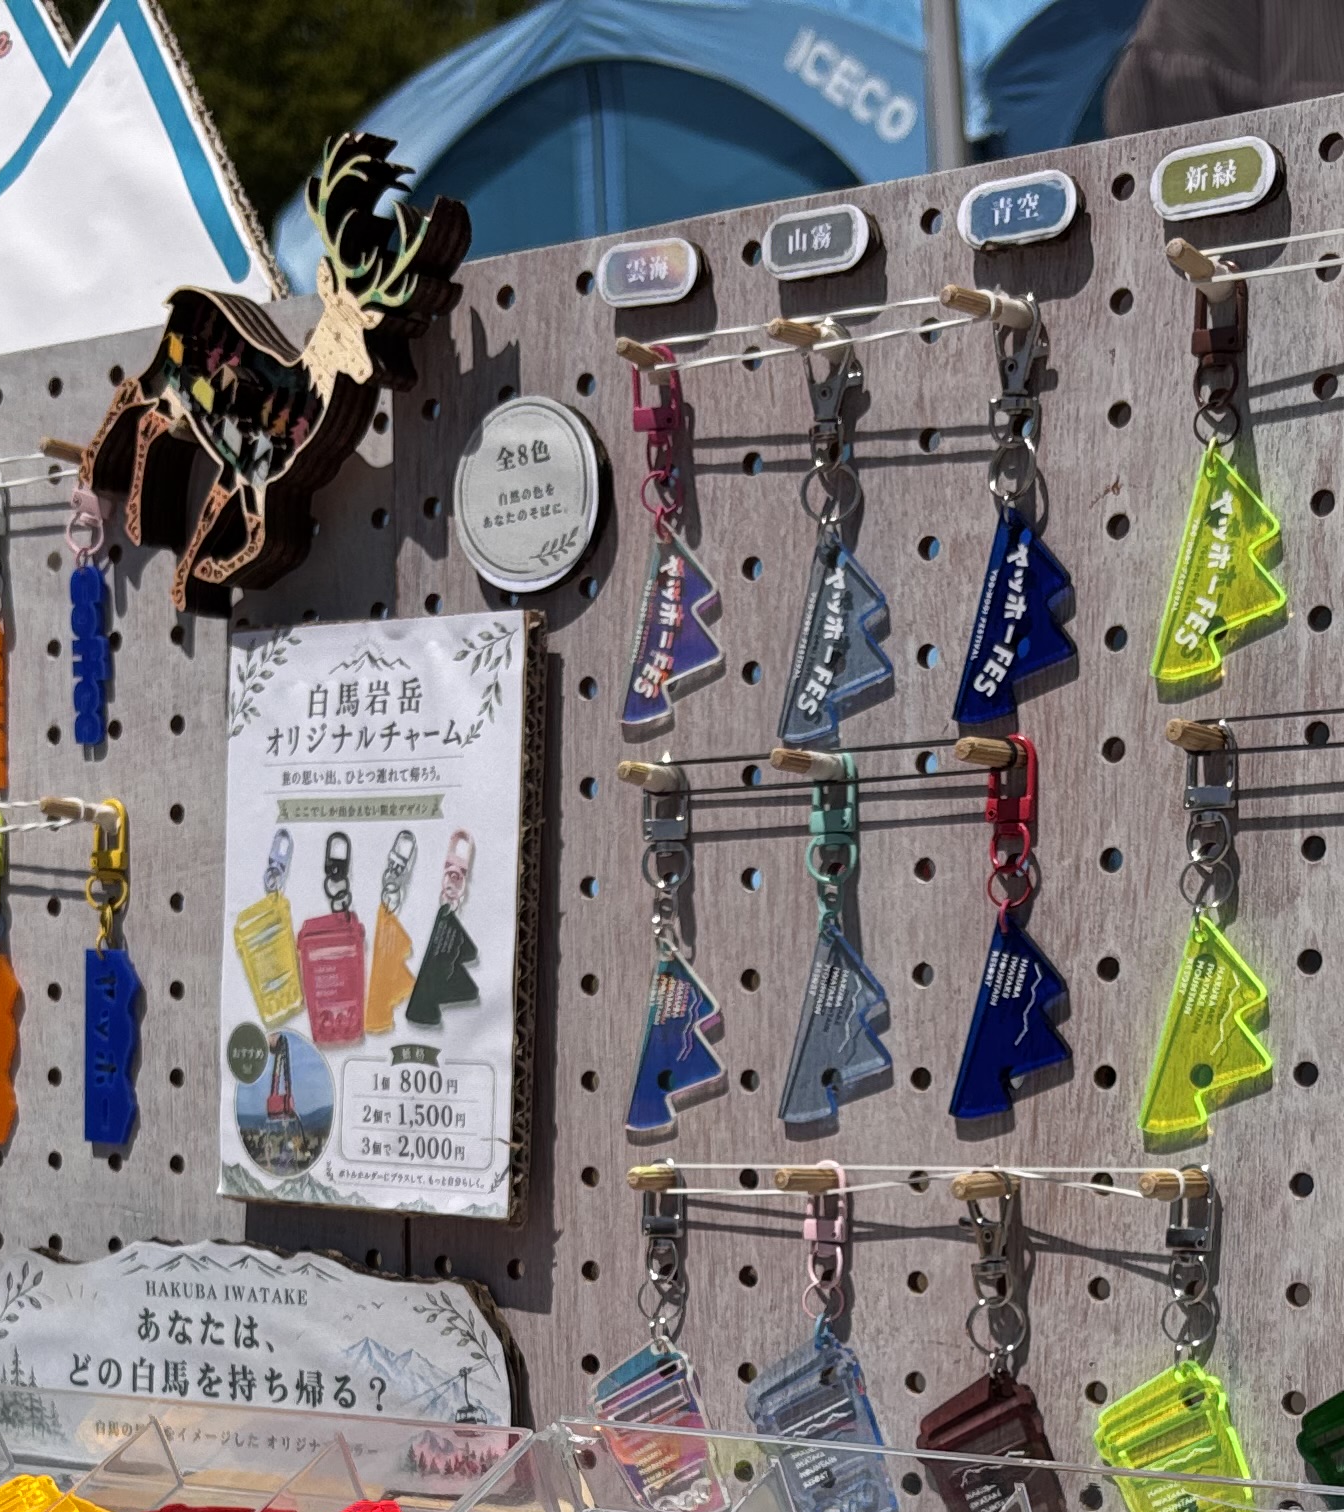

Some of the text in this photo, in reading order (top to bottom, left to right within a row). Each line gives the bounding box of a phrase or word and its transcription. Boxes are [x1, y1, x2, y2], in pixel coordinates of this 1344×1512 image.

[783, 26, 919, 143] ICECO
[1184, 157, 1238, 195] 新緑
[990, 191, 1041, 224] 青空
[787, 220, 832, 256] 山霧
[495, 439, 552, 472] 全8色
[497, 483, 556, 506] 自然の色を
[1174, 491, 1234, 650] ヤッホーFES
[973, 543, 1030, 698] ヤッホーFES
[796, 568, 847, 717] ヤッホーFES
[307, 676, 424, 719] 白馬岩岳
[265, 719, 462, 757] オリジナルチャーム
[400, 1069, 458, 1095] 800円
[398, 1103, 466, 1128] 1,500円
[397, 1136, 465, 1162] 2,000円
[145, 1279, 308, 1306] HAKUBA IWATAKE
[137, 1306, 277, 1355] あなたは、
[69, 1353, 387, 1413] どの白馬を持ち帰る？
